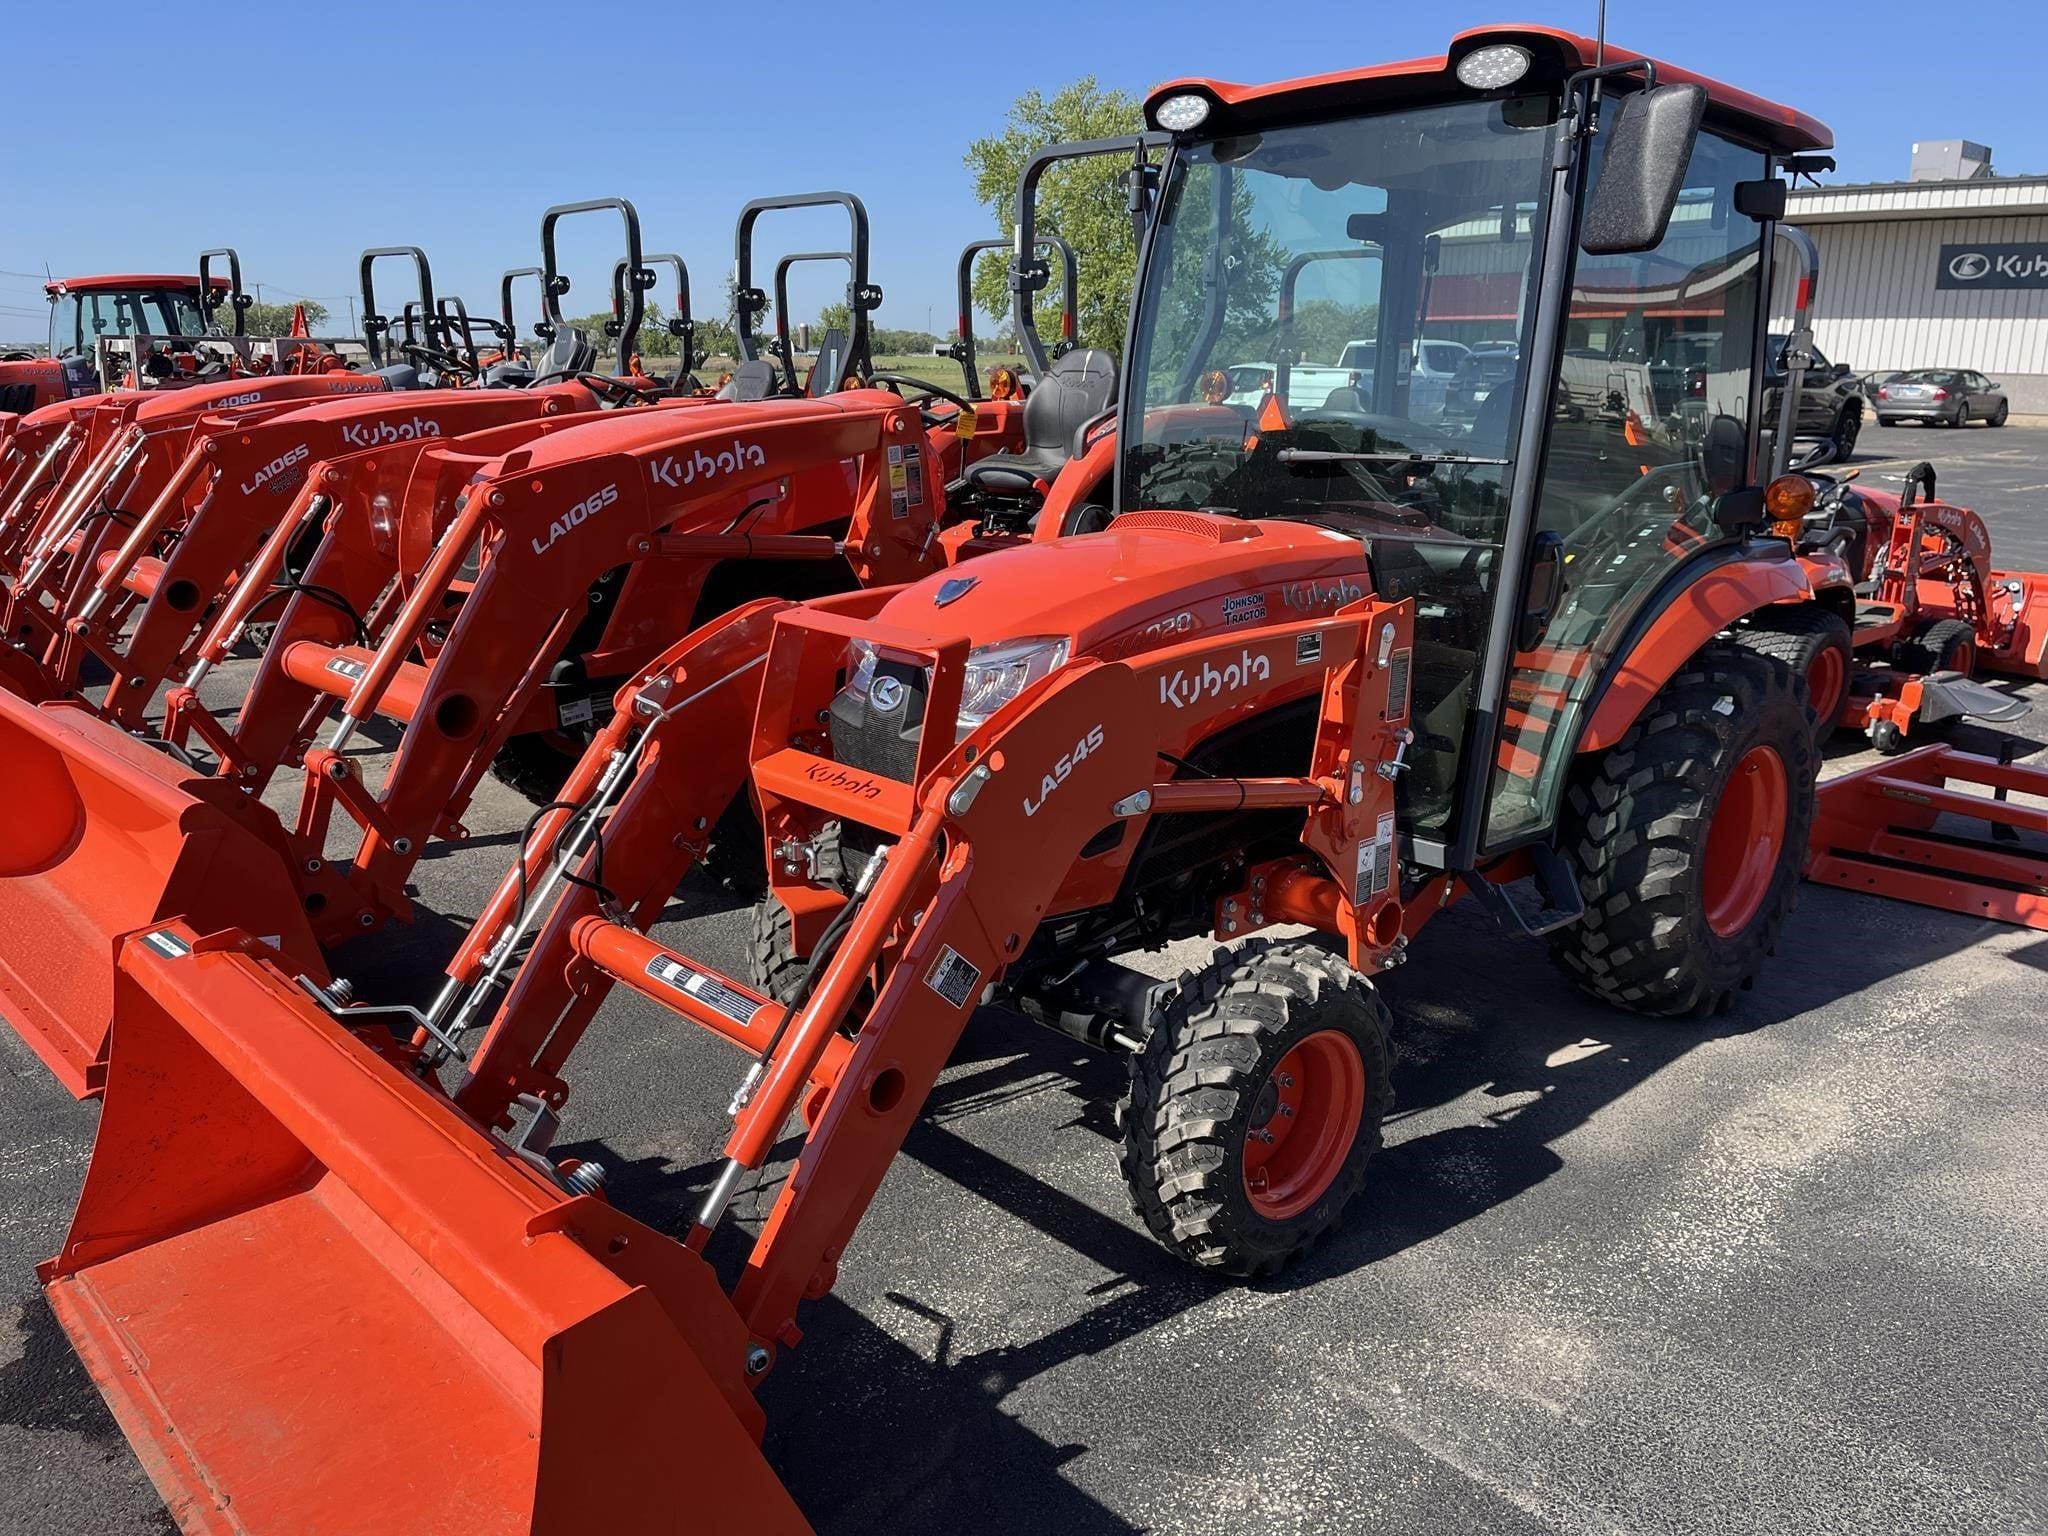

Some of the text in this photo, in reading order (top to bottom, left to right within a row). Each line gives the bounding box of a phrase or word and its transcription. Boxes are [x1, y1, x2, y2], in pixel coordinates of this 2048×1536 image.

[208, 392, 260, 410] L4060
[342, 416, 440, 446] Kubota
[240, 443, 309, 496] LA1065
[650, 440, 766, 488] Kubota
[530, 483, 619, 555] LA1065
[1222, 593, 1265, 612] JOHNSON
[1282, 578, 1362, 613] Kubota
[1224, 607, 1267, 626] TRACTOR
[1159, 649, 1270, 709] Kubota
[805, 762, 882, 799] Kubota
[1023, 723, 1104, 817] LA545
